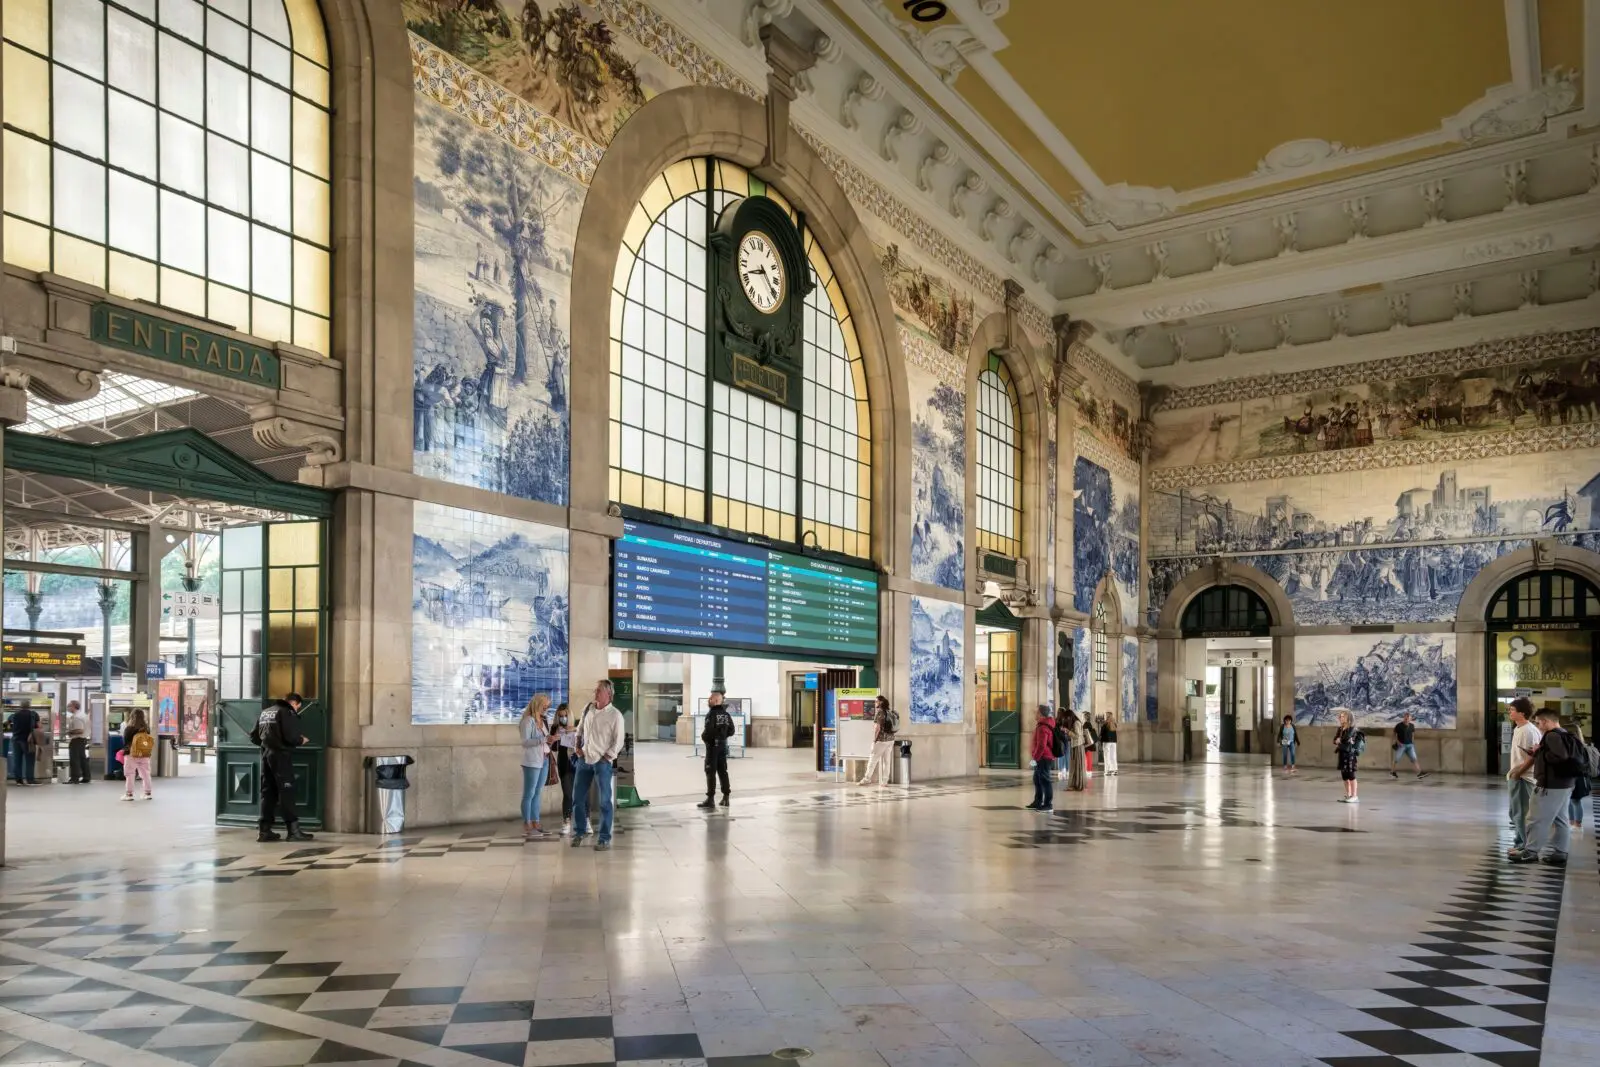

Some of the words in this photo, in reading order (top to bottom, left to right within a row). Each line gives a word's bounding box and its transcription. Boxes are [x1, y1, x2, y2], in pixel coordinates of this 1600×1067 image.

[107, 312, 266, 380] ENTRADA
[673, 533, 694, 544] PARTIDAS
[696, 538, 722, 549] DEPARTURES
[1503, 663, 1539, 673] CENTRO
[1509, 672, 1573, 681] MOBILIDADE
[259, 710, 278, 721] PSG
